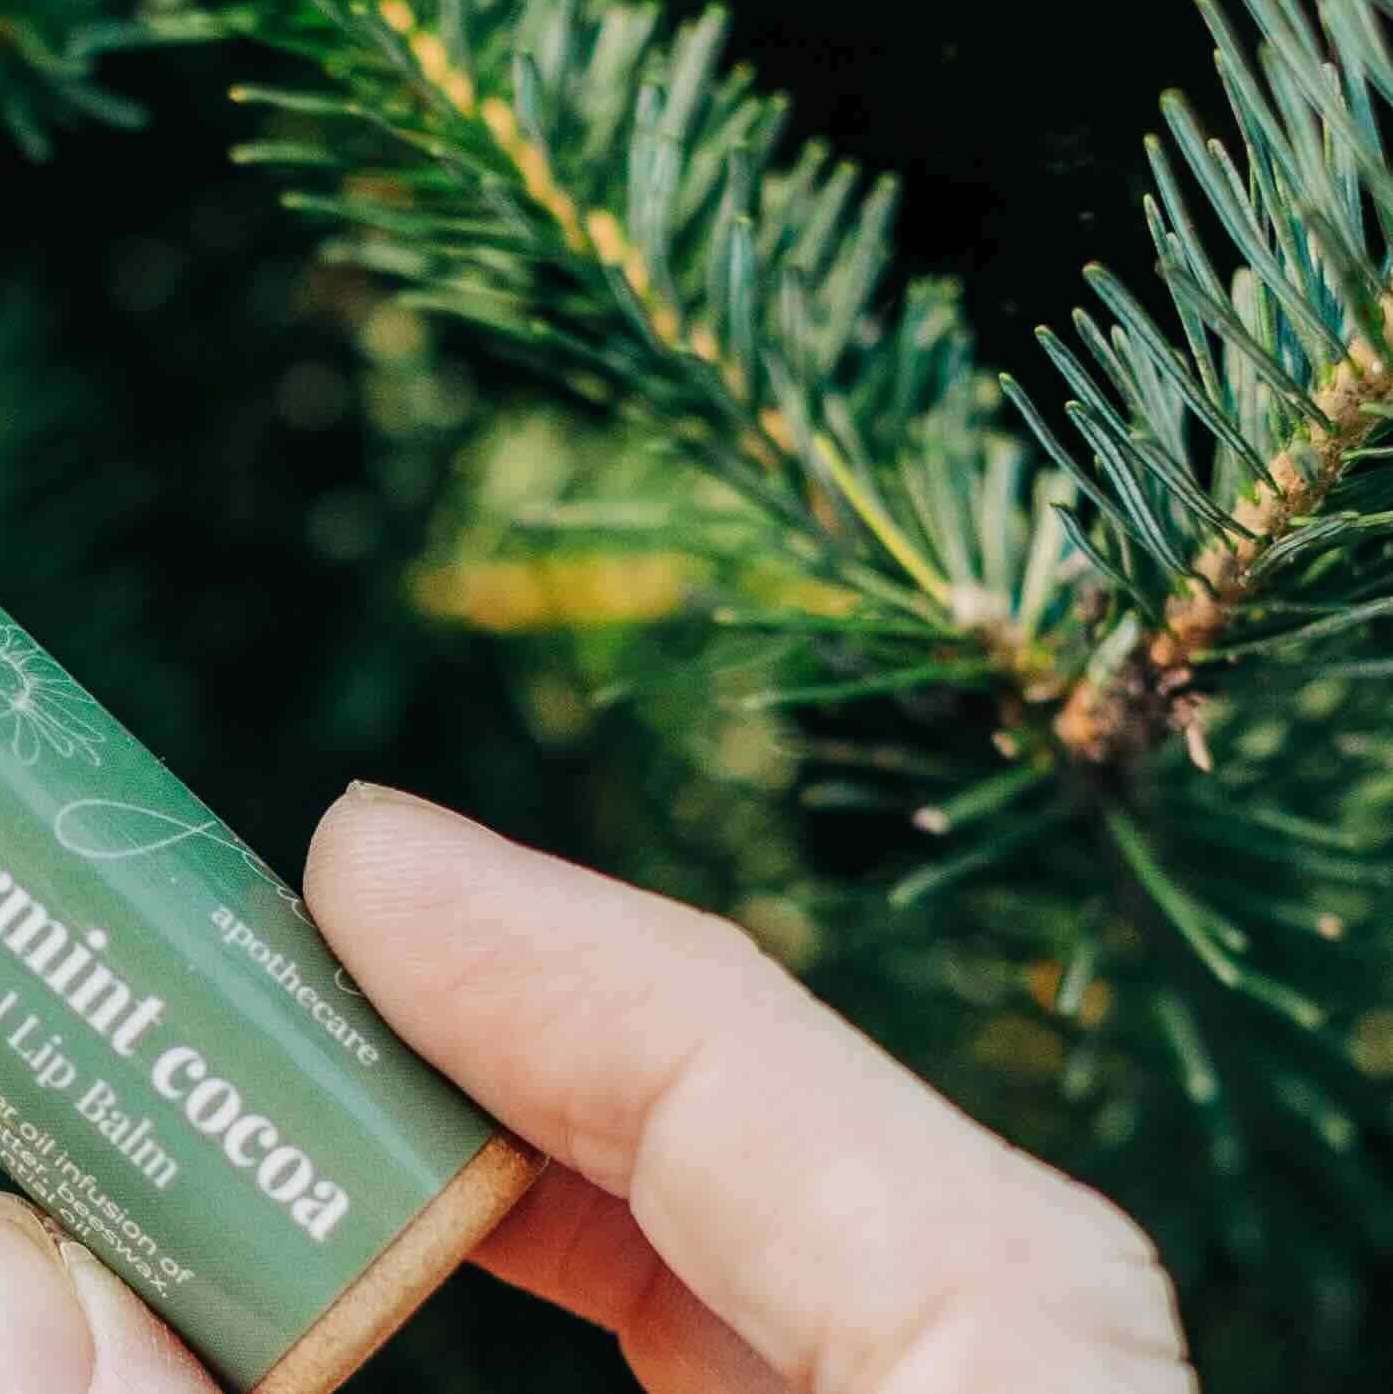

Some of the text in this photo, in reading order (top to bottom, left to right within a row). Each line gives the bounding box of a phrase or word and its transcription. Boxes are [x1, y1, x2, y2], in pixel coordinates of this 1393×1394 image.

[211, 906, 378, 1066] apothecare
[7, 1014, 77, 1090] Lip
[75, 1079, 179, 1190] Balm
[151, 1046, 351, 1244] cocoa
[19, 1121, 56, 1155] oil
[54, 1149, 158, 1256] infusion
[158, 1256, 196, 1284] of
